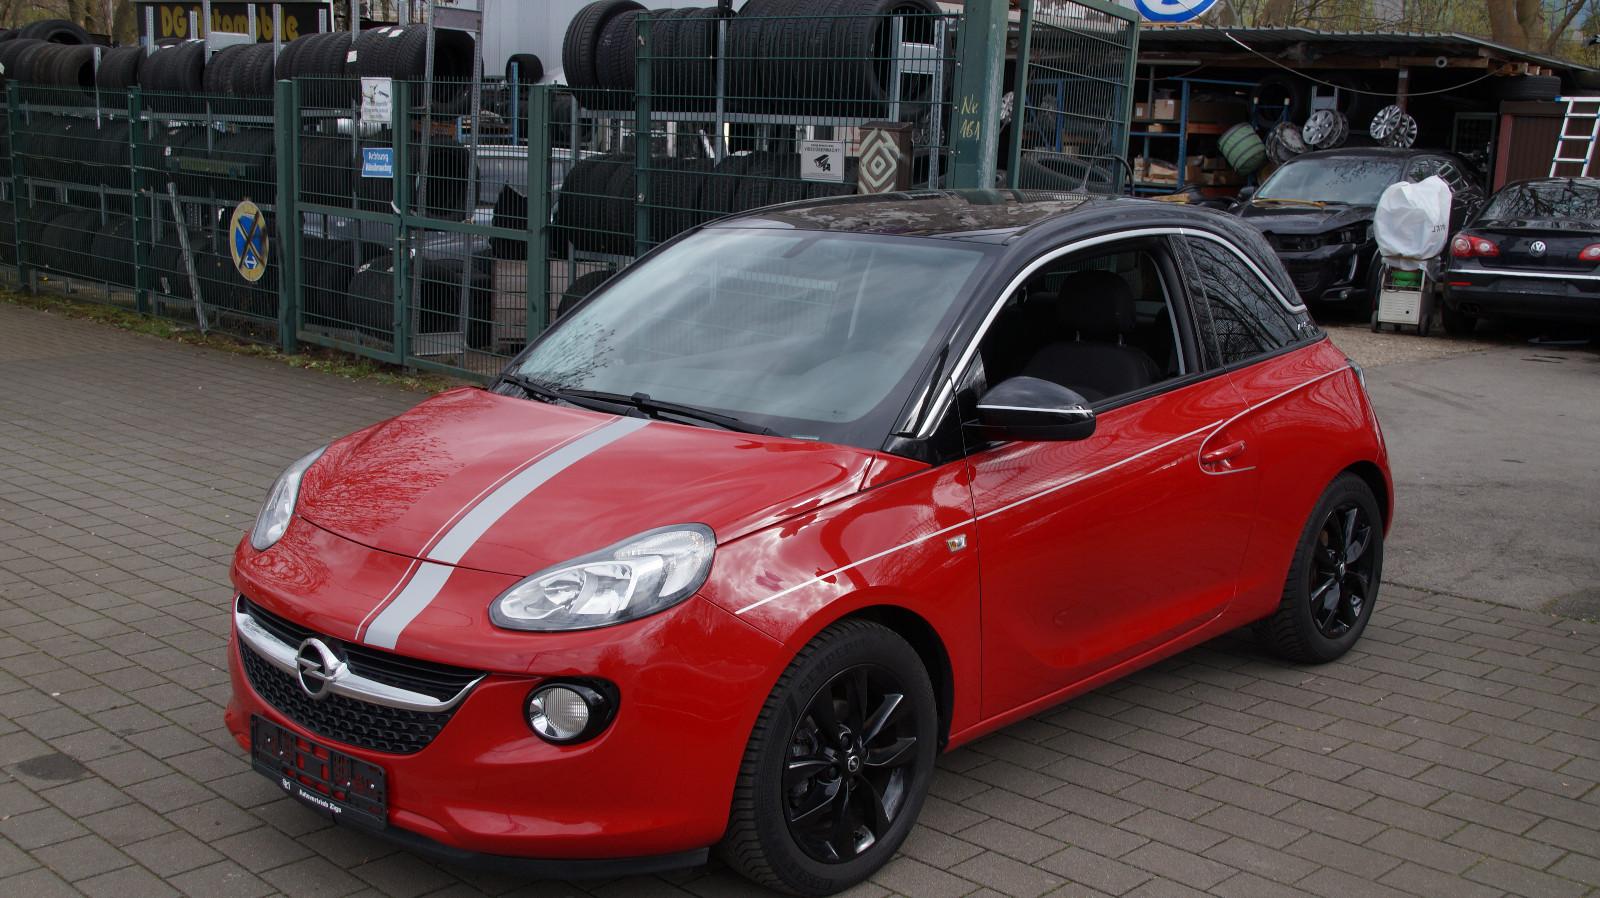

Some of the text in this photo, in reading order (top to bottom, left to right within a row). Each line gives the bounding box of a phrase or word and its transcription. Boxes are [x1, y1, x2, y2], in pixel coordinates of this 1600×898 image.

[161, 6, 299, 41] DG Atomble
[368, 151, 389, 163] Achtung
